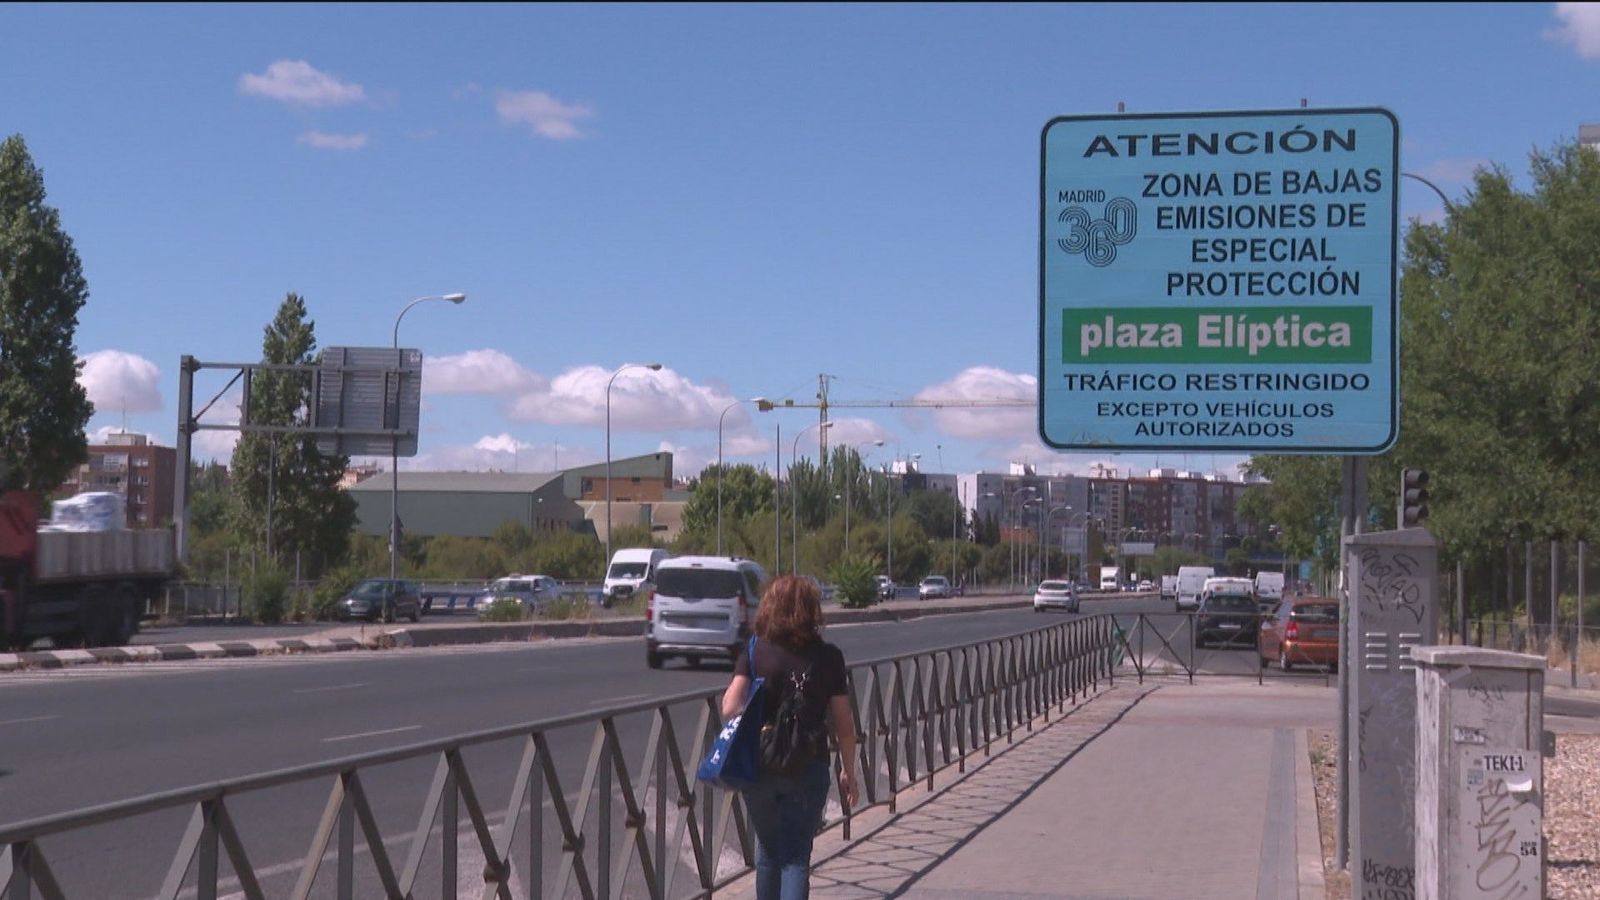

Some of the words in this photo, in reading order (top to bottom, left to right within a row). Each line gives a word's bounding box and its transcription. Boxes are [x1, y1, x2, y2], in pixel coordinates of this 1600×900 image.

[1083, 125, 1356, 158] ATENCIÓN
[1058, 190, 1105, 203] MADRID
[1142, 173, 1224, 198] ZONA
[1233, 171, 1271, 195] DE
[1282, 169, 1382, 194] BAJAS
[1156, 204, 1316, 230] EMISIONES
[1327, 203, 1366, 227] DE
[1058, 197, 1137, 267] 360
[1191, 237, 1336, 263] ESPECIAL
[1167, 266, 1360, 297] PROTECCIÓN
[1080, 315, 1182, 356] plaza
[1198, 314, 1351, 356] Elíptica
[1064, 370, 1176, 392] TRÁFICO
[1186, 372, 1369, 391] RESTRINGIDO
[1097, 403, 1198, 418] EXCEPTO
[1207, 399, 1334, 417] VEHÍCULOS
[1135, 421, 1294, 437] AUTORIZADOS
